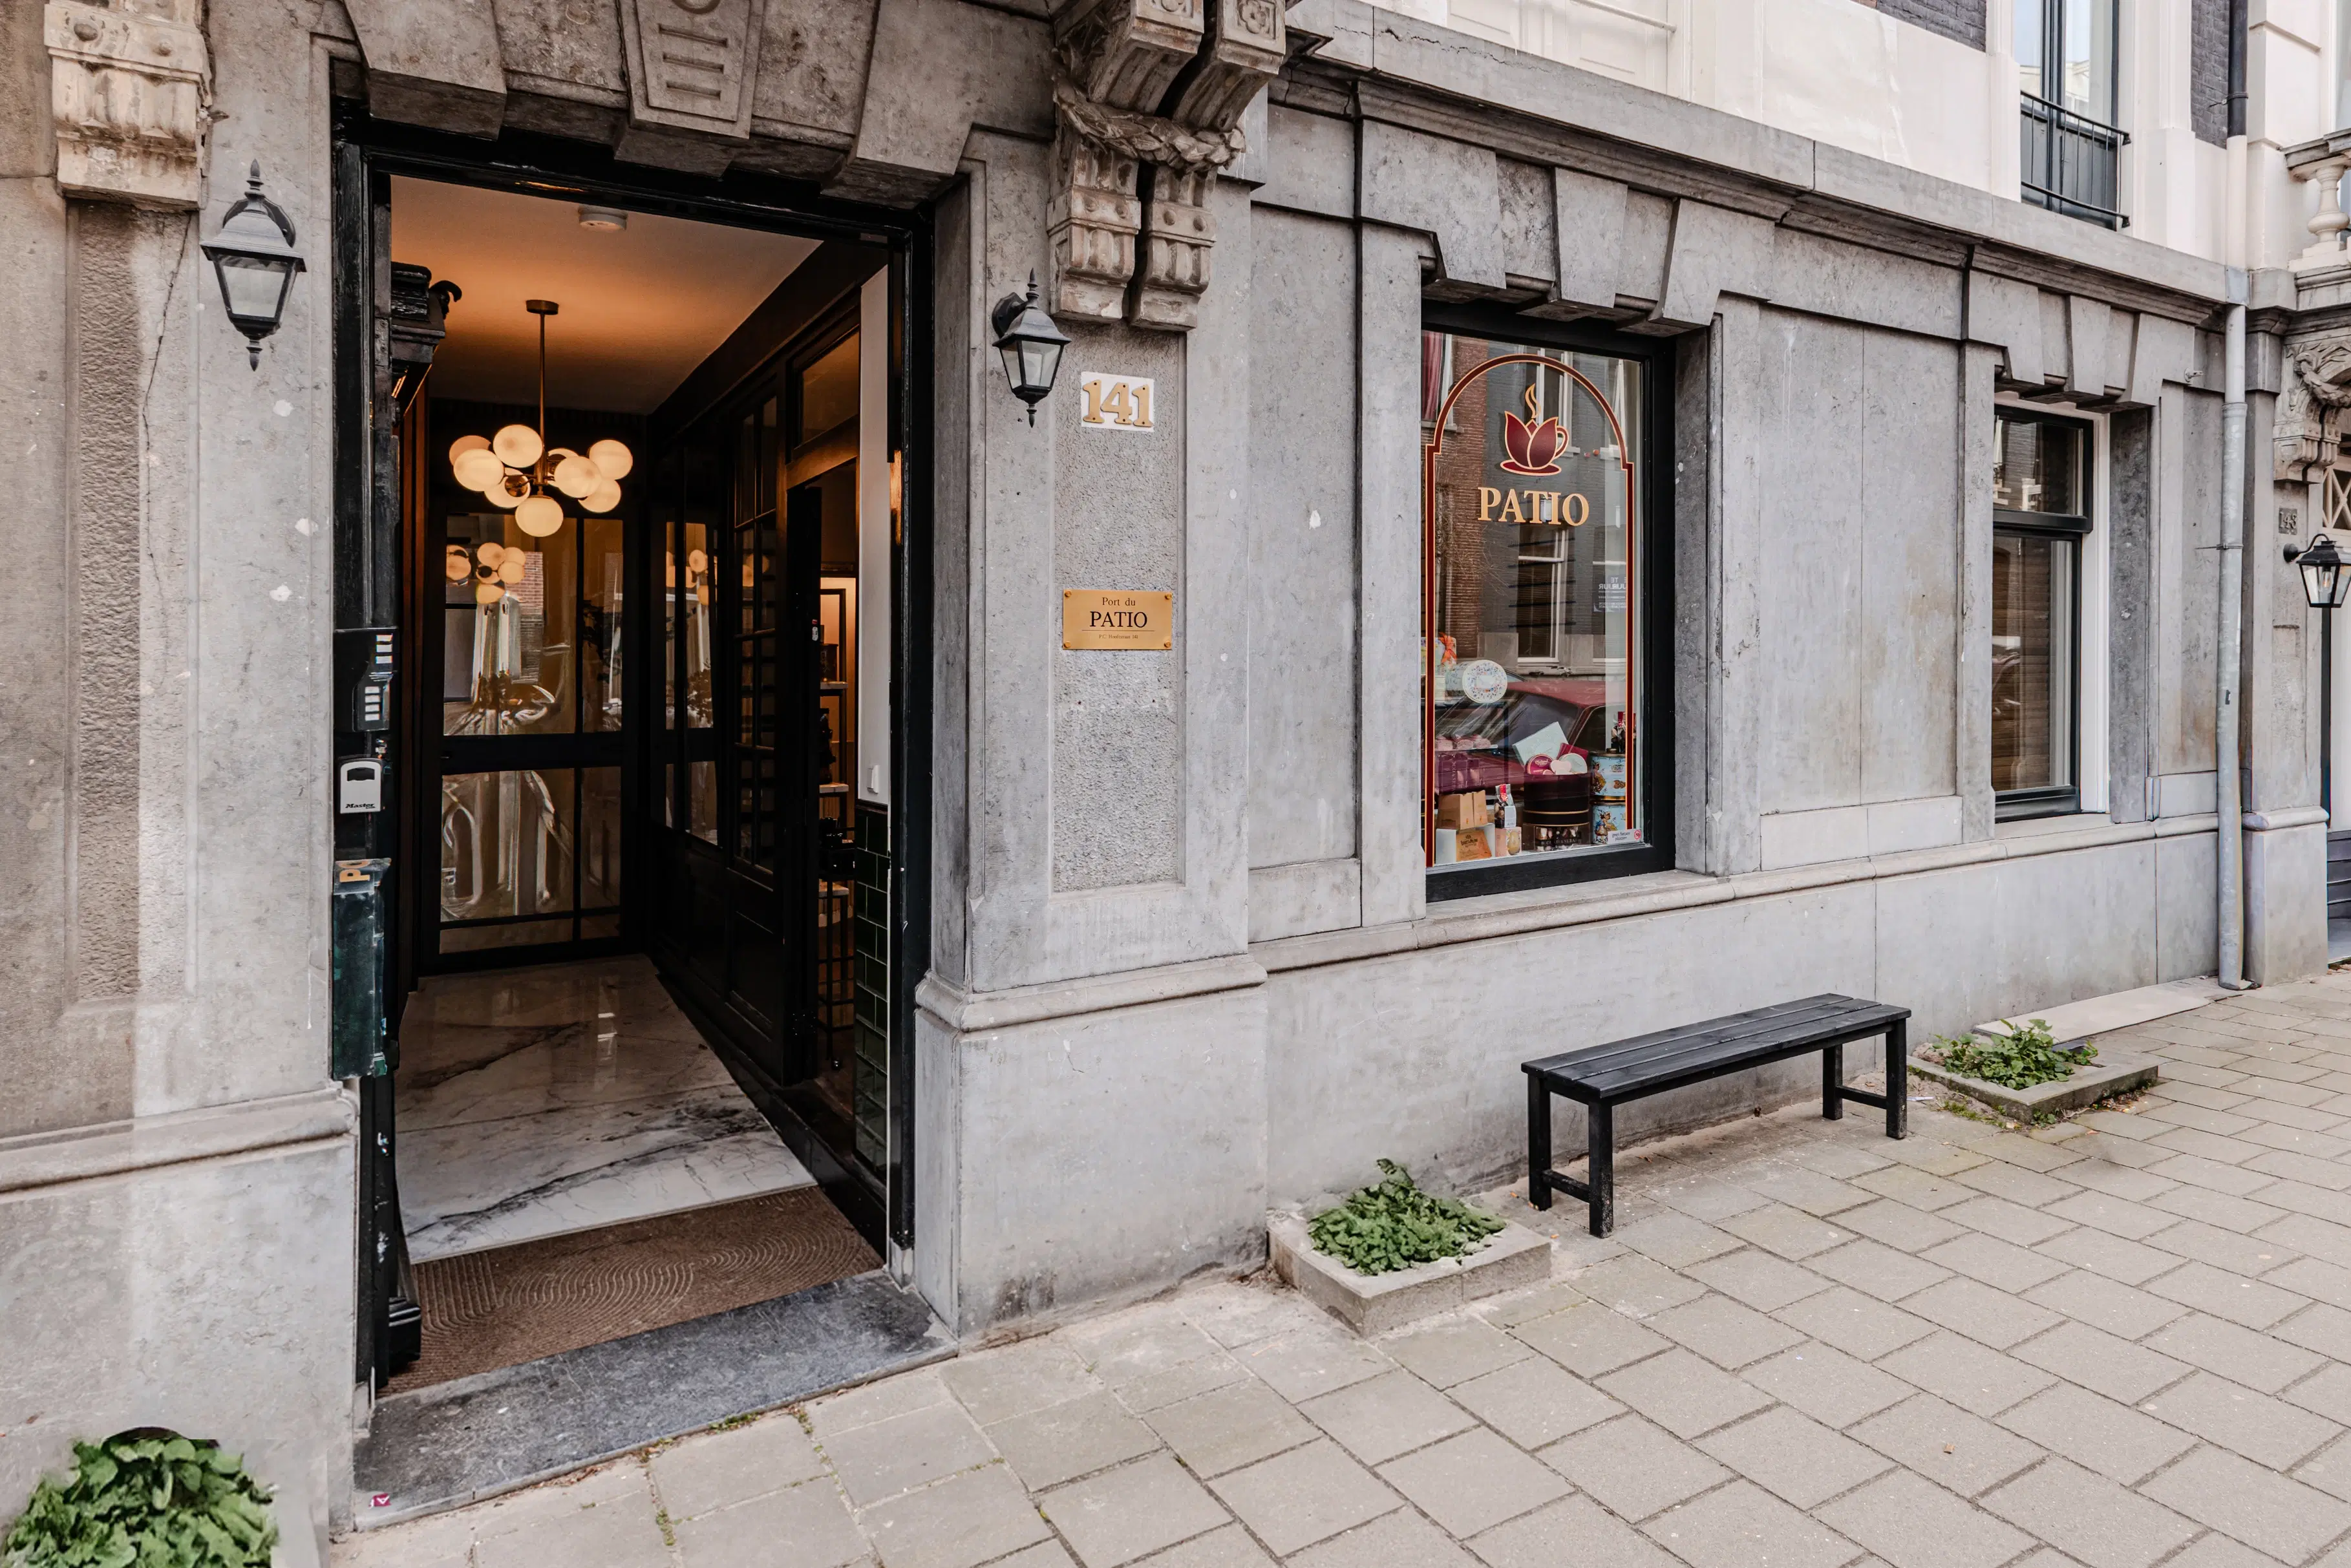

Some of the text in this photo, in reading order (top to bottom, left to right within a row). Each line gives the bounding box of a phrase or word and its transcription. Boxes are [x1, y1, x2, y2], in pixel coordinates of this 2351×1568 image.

[1083, 379, 1153, 427] 141
[1478, 487, 1590, 527] PATIO
[1101, 597, 1136, 606] Port du
[1089, 611, 1148, 628] PATIO
